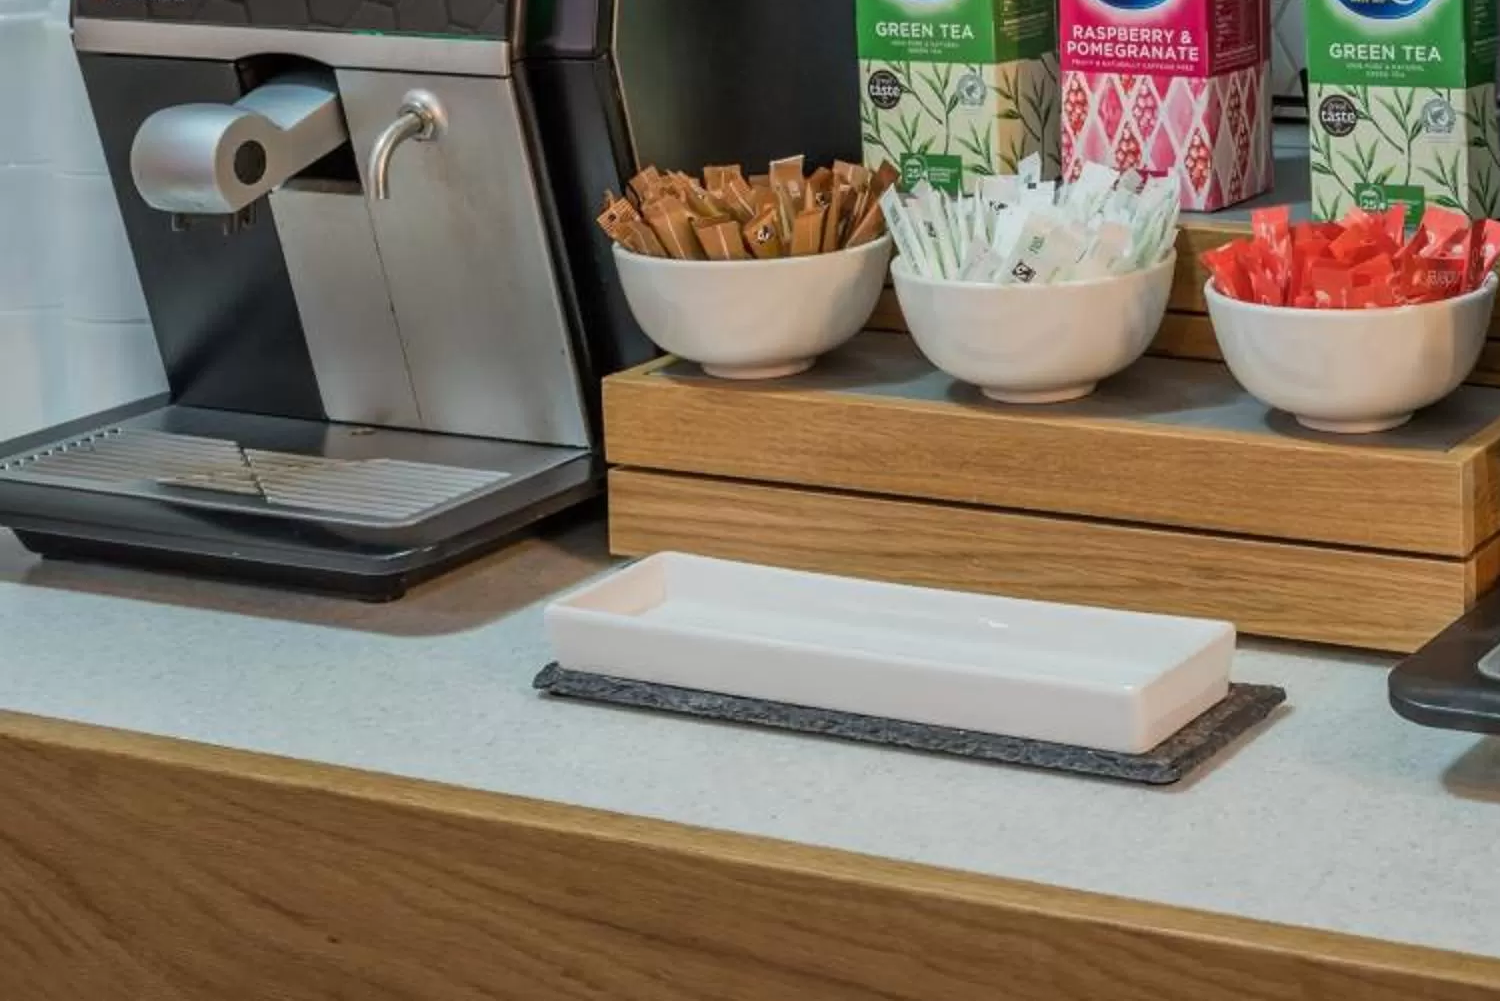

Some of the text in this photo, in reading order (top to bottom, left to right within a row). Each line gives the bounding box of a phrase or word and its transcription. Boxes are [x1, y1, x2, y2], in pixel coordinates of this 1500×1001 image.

[875, 22, 975, 40] GREEN TEA
[1072, 25, 1193, 45] RASPBERRY &
[1066, 40, 1199, 62] POMEGRANATE
[1329, 43, 1441, 62] GREEN TEA
[1321, 110, 1357, 124] taste
